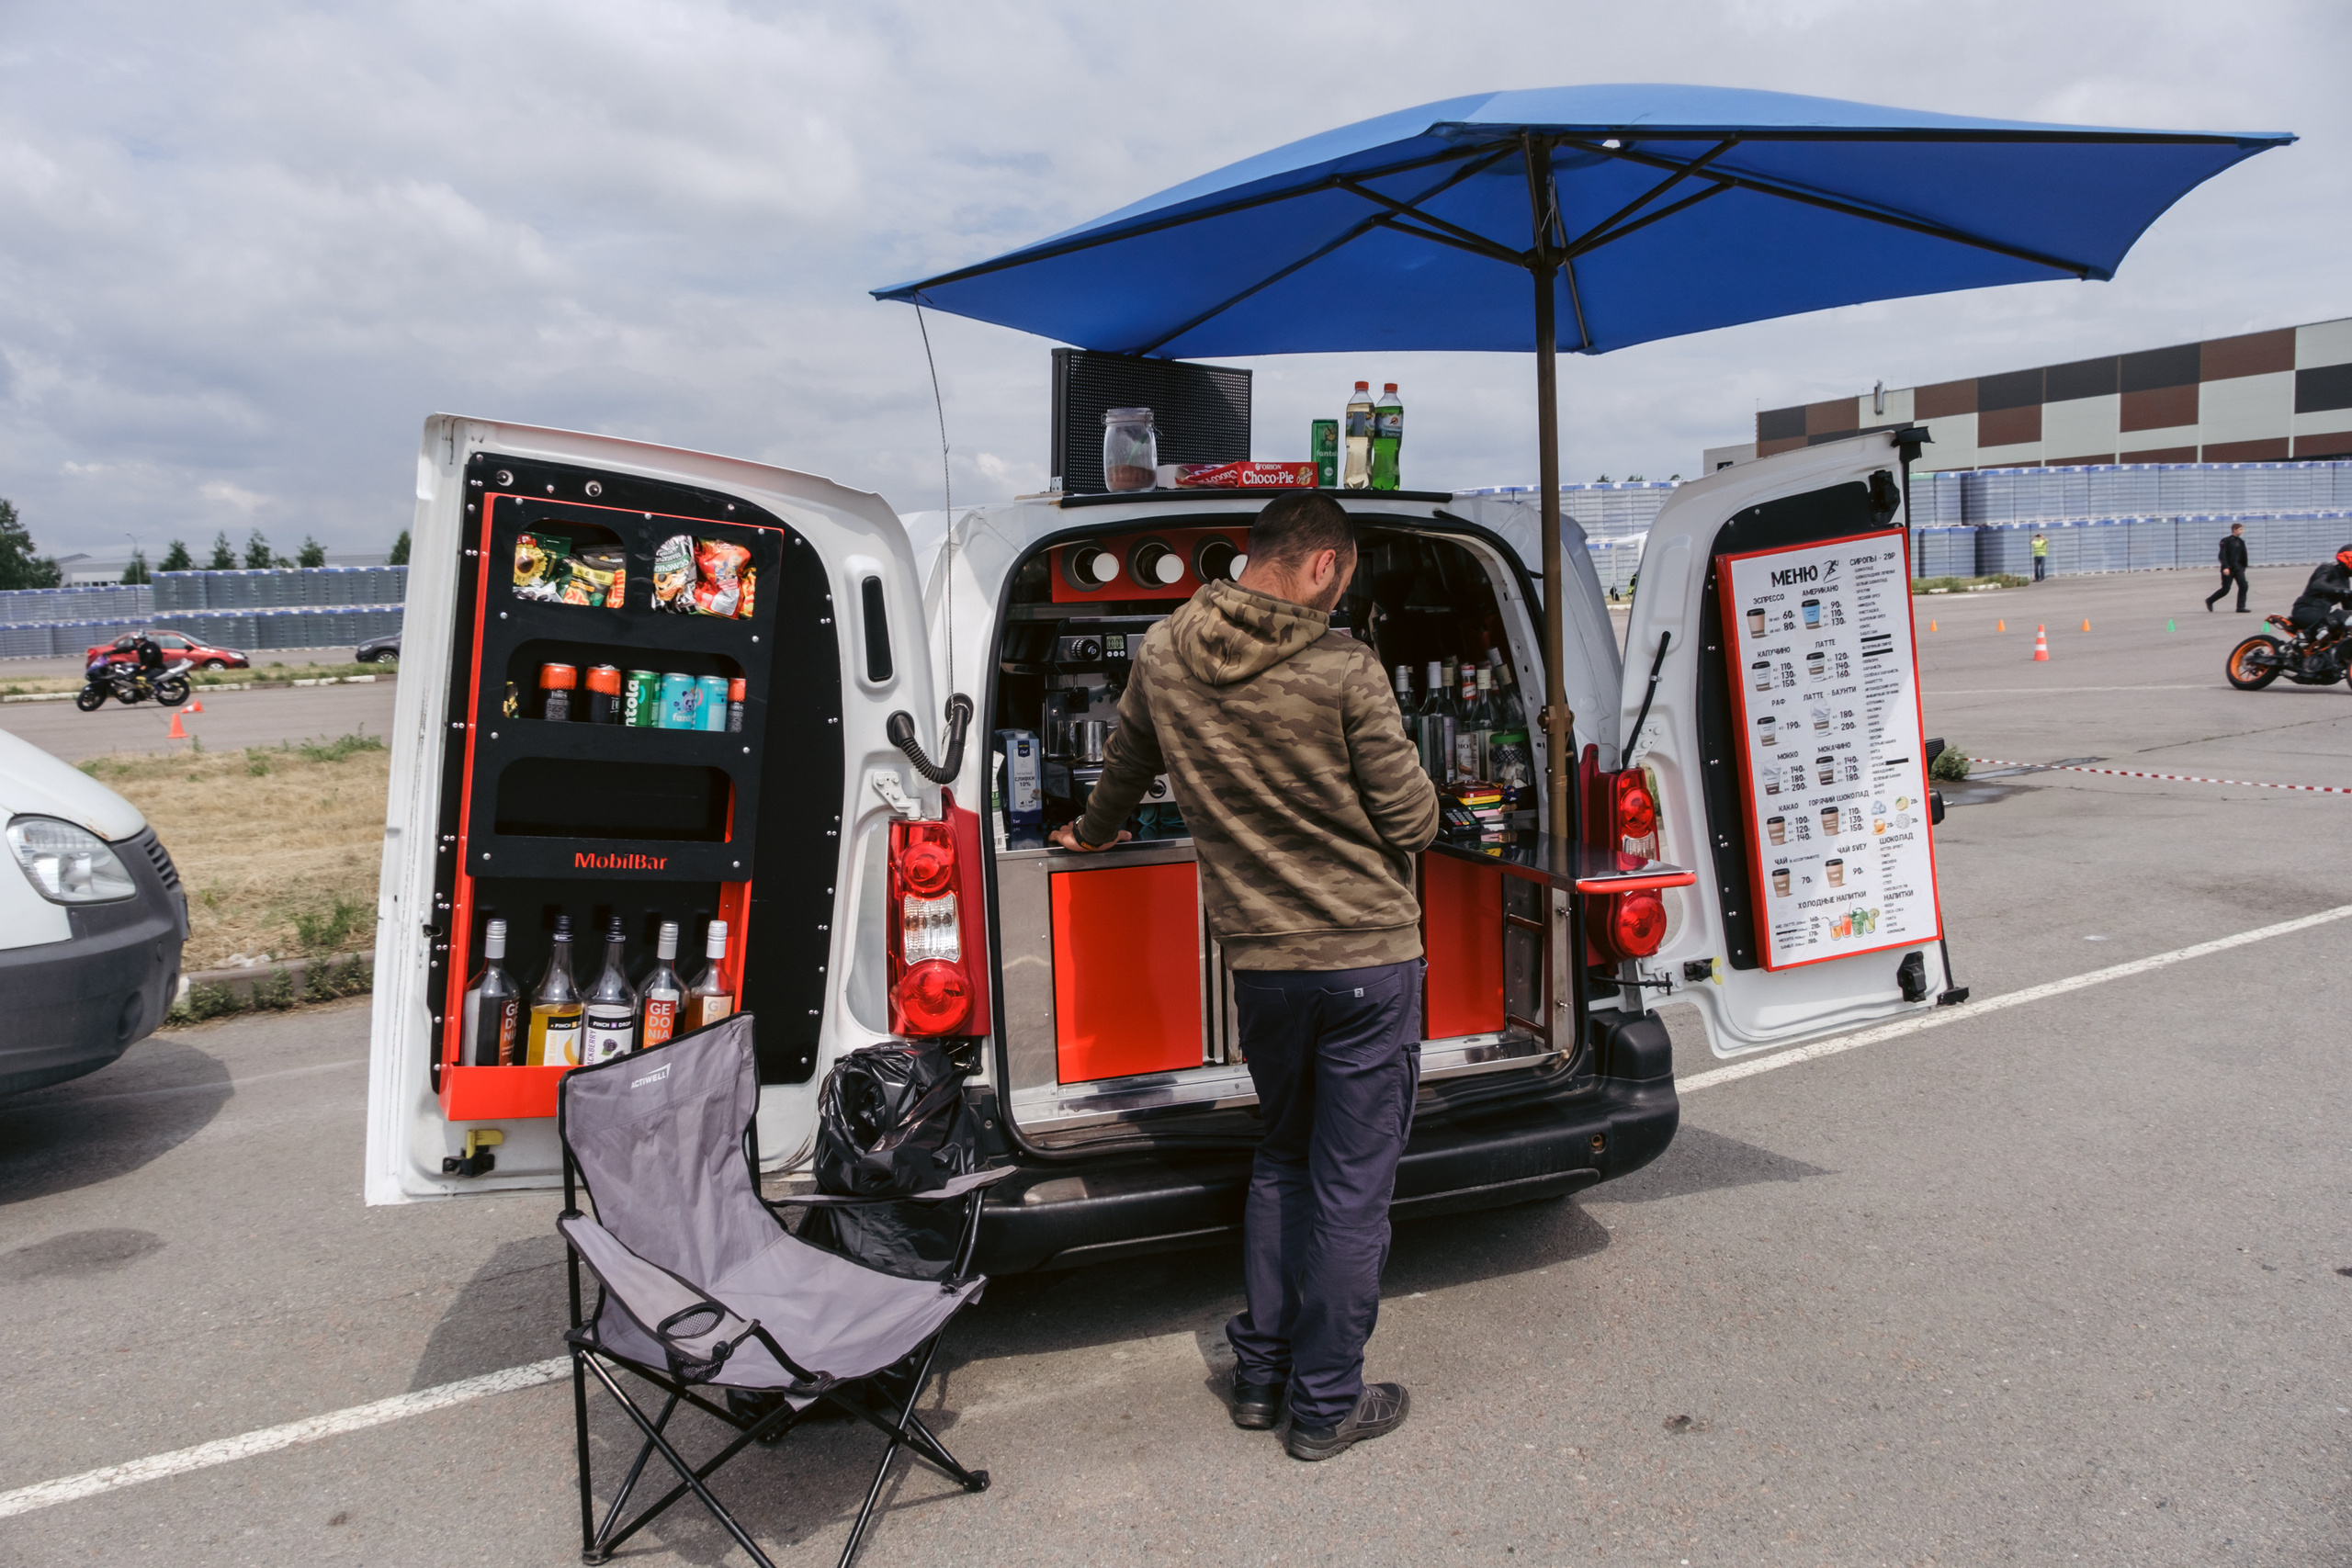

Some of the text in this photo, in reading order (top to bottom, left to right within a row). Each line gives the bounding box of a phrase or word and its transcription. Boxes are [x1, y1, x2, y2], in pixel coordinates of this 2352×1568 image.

[1849, 555, 1877, 566] СИРОПЫ
[1770, 565, 1818, 587] МЕНЮ
[1802, 584, 1839, 597] АМЕРИКАНО
[1753, 593, 1785, 604] ЭСПРЕССО
[1815, 638, 1836, 649] ЛАТТЕ
[1757, 646, 1791, 658] КАПУЧИНО
[1803, 691, 1824, 701] ЛАТТЕ
[1831, 686, 1857, 696] БАУНТИ
[1771, 698, 1786, 706] РАФ
[1817, 741, 1851, 753] МОКАЧИНО
[1777, 750, 1799, 761] МОККО
[1808, 789, 1870, 807] ГОРЯЧИЙ ШОКОЛАД
[1778, 802, 1799, 812] КАКАО
[1879, 831, 1914, 845] ШОКОЛАД
[1837, 844, 1850, 854] ЧАЙ
[574, 852, 668, 870] MobilBar
[1774, 856, 1788, 865] ЧАЙ
[1797, 890, 1867, 909] ХОЛОДНЫЕ НАПИТКИ
[1883, 889, 1914, 901] НАПИТКИ
[650, 1002, 672, 1016] GE
[707, 1000, 728, 1012] GE
[649, 1016, 671, 1028] DO
[648, 1030, 670, 1040] NIA
[630, 1071, 666, 1089] ACTIWELL
